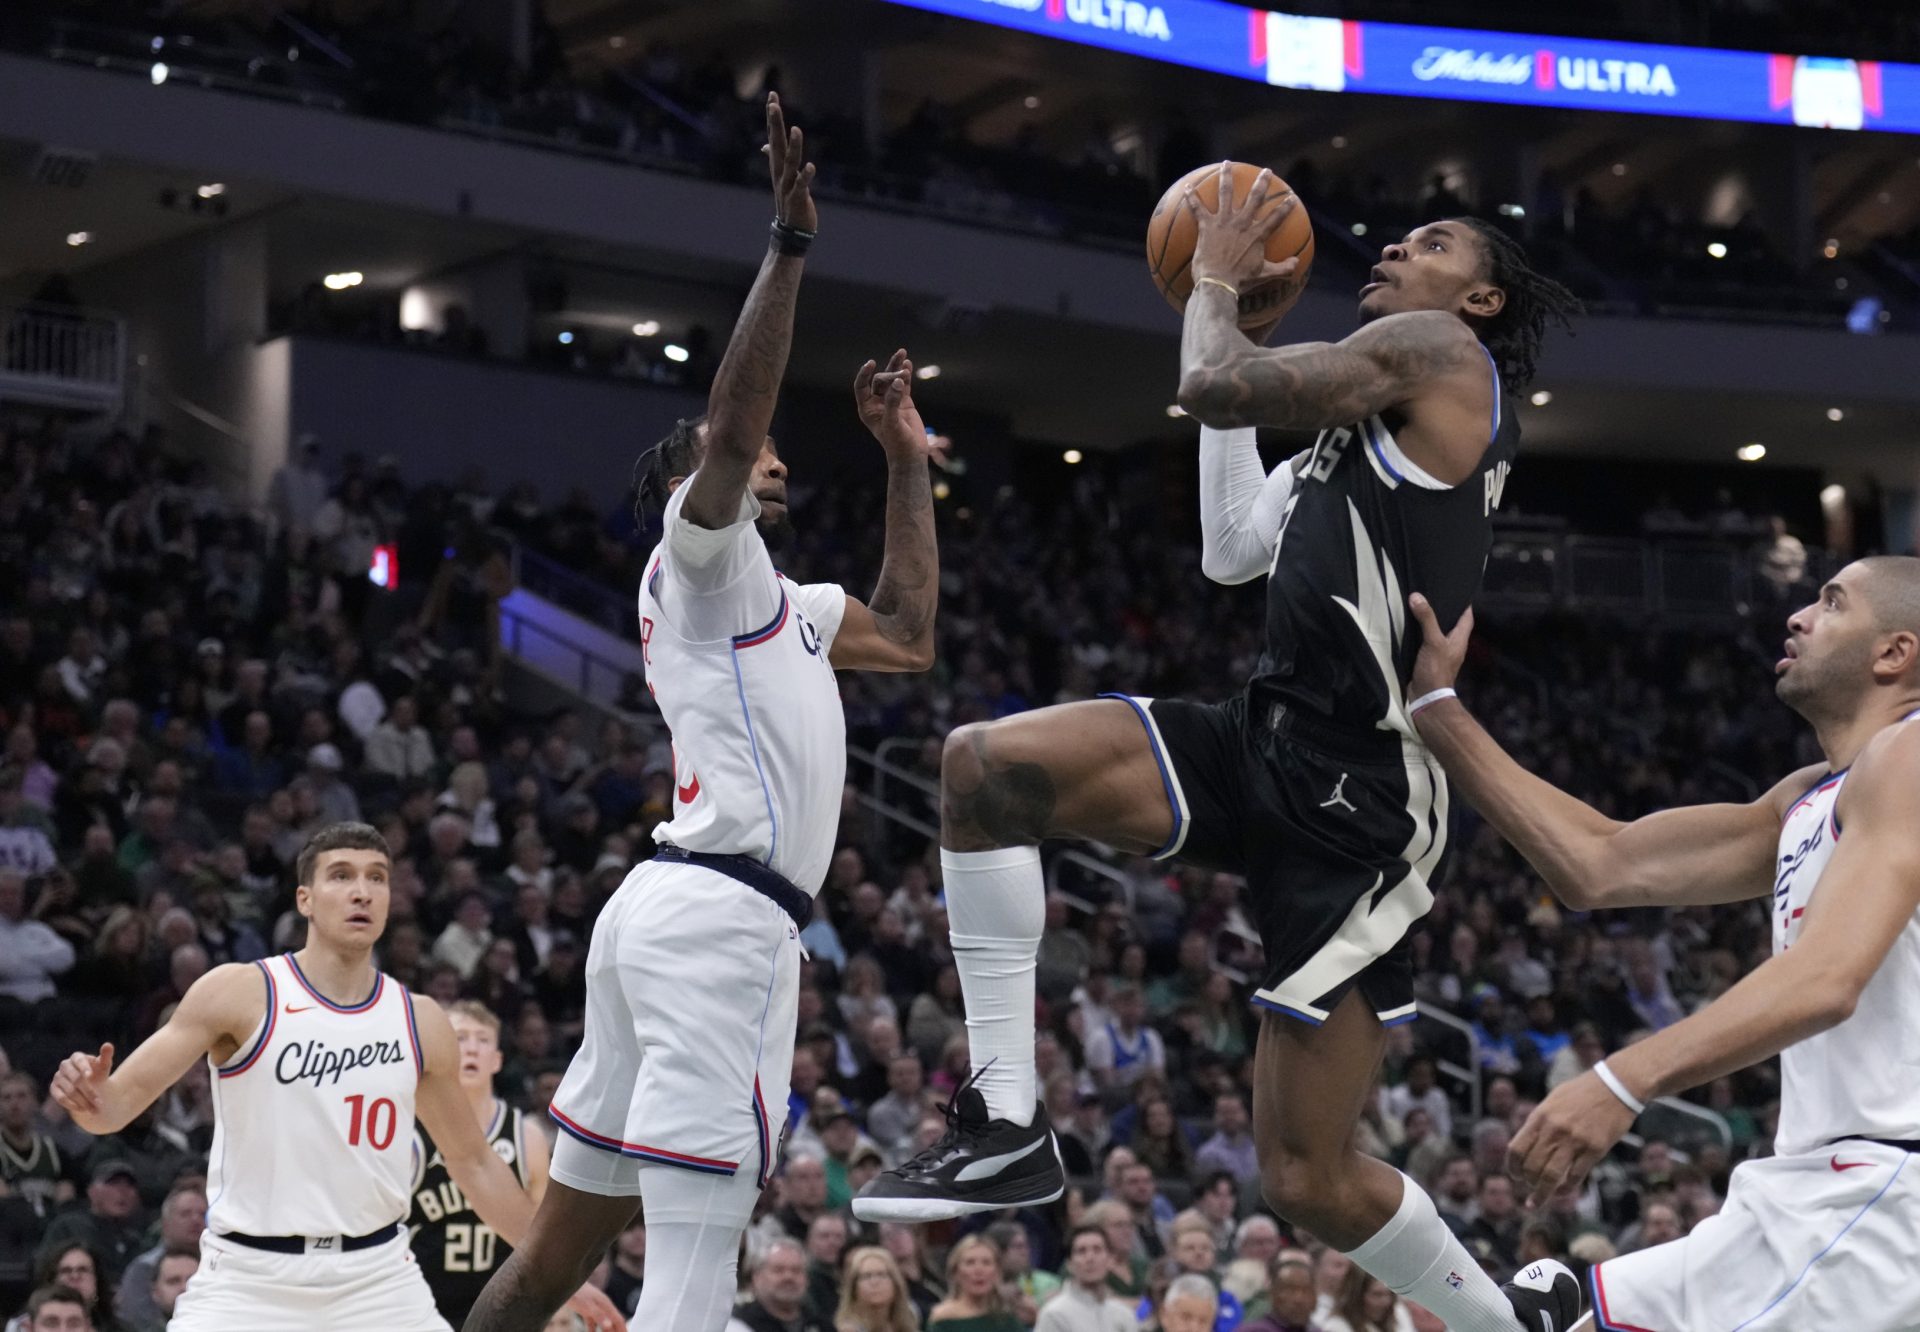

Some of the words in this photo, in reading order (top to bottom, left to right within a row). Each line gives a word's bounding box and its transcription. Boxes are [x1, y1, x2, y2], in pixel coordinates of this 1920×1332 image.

[1067, 0, 1172, 41] ULTRA
[1557, 56, 1677, 96] ULTRA
[275, 1039, 405, 1087] Clippers
[344, 1094, 397, 1151] 10
[416, 1180, 472, 1223] BU
[444, 1223, 497, 1272] 20
